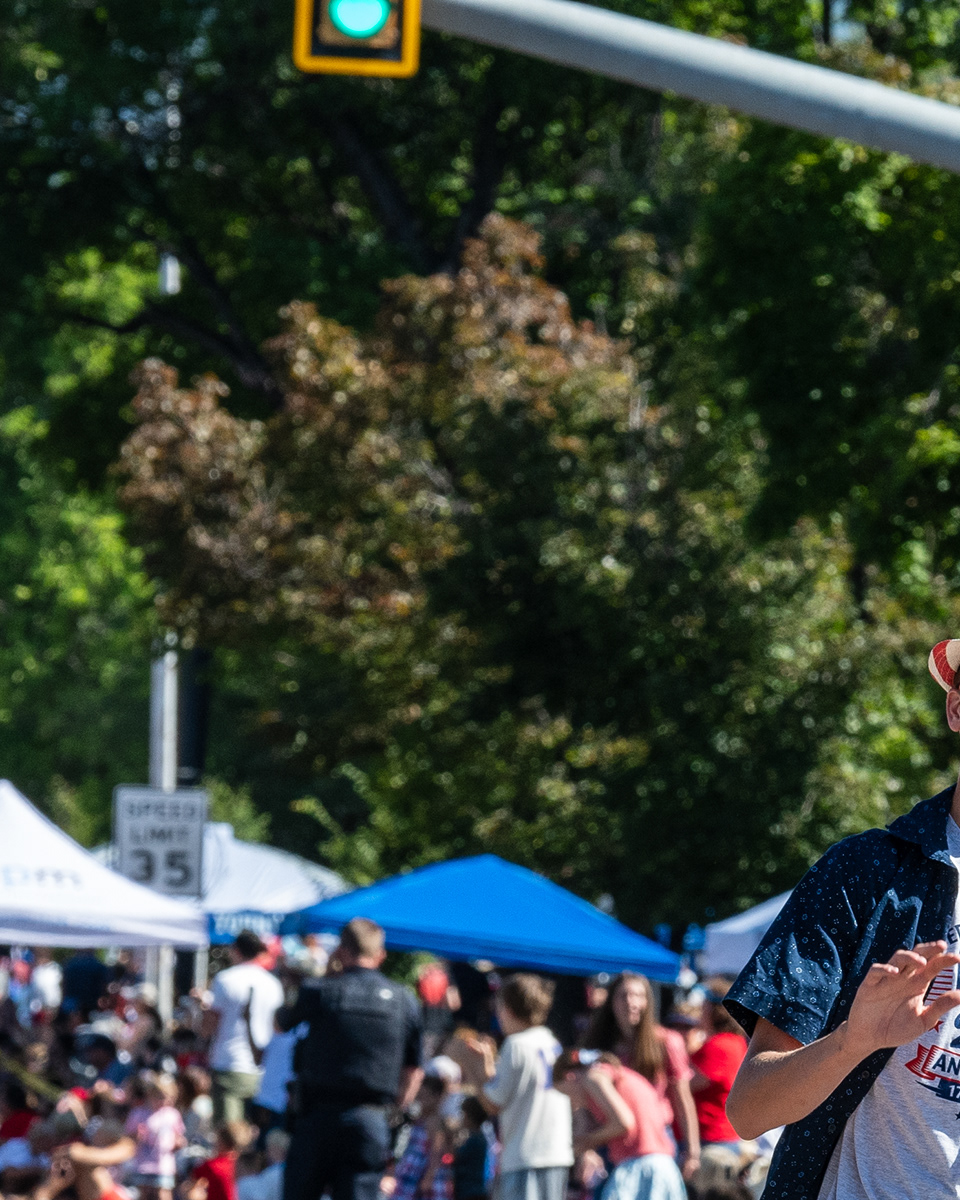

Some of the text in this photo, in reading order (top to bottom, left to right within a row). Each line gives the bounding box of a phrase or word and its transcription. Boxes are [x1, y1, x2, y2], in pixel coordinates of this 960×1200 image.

[127, 803, 196, 818] SPEED
[129, 827, 190, 841] LIMIT
[131, 849, 192, 888] 35
